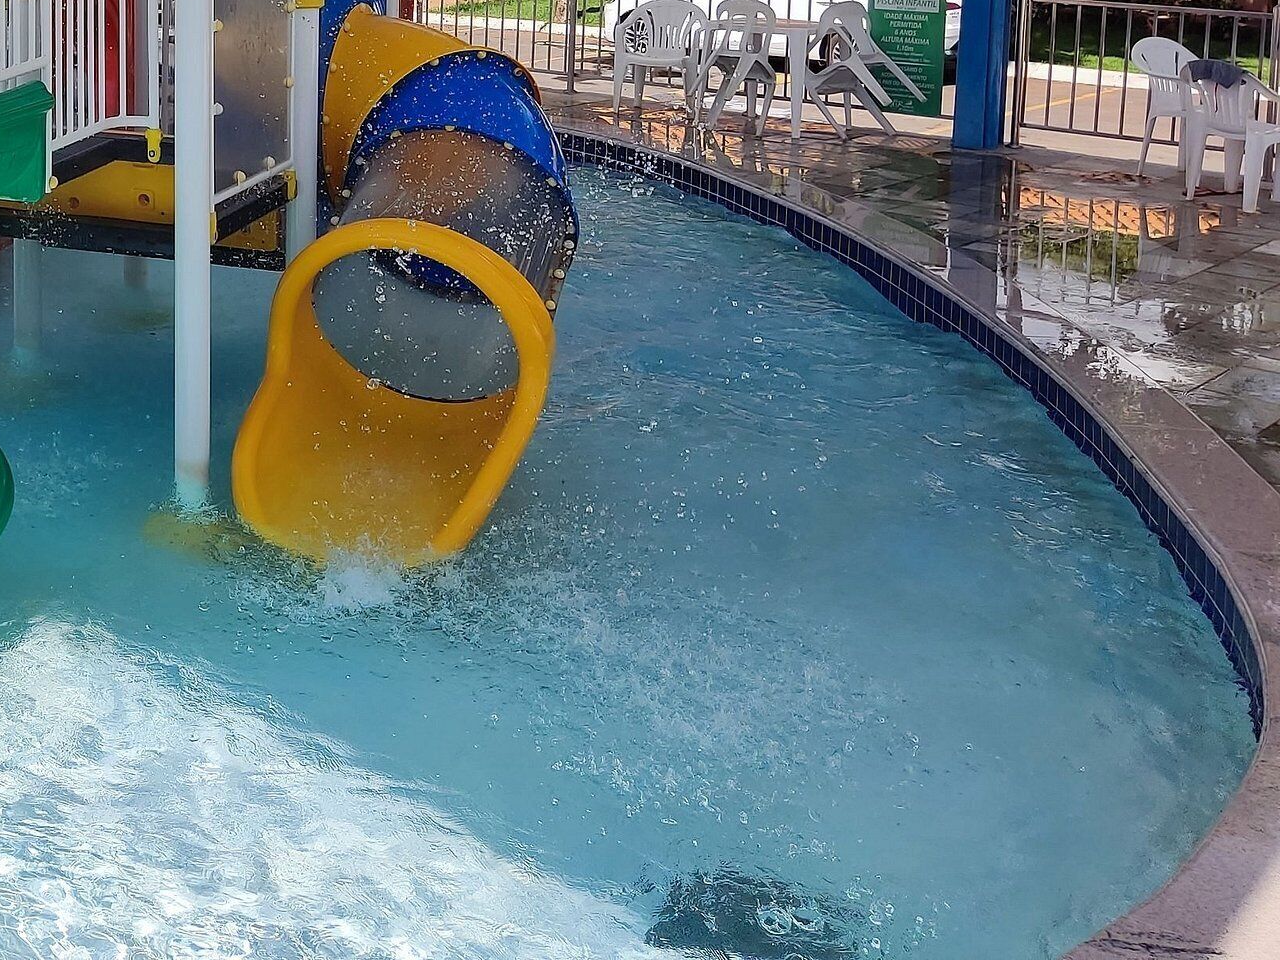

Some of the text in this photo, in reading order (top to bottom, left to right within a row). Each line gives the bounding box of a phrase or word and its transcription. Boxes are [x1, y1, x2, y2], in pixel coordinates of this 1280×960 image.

[883, 12, 929, 22] IDADE MÁXIMA
[889, 20, 922, 29] PERMITIDA
[899, 29, 917, 37] ANOS
[880, 35, 930, 45] ALTURA MÁXIMA
